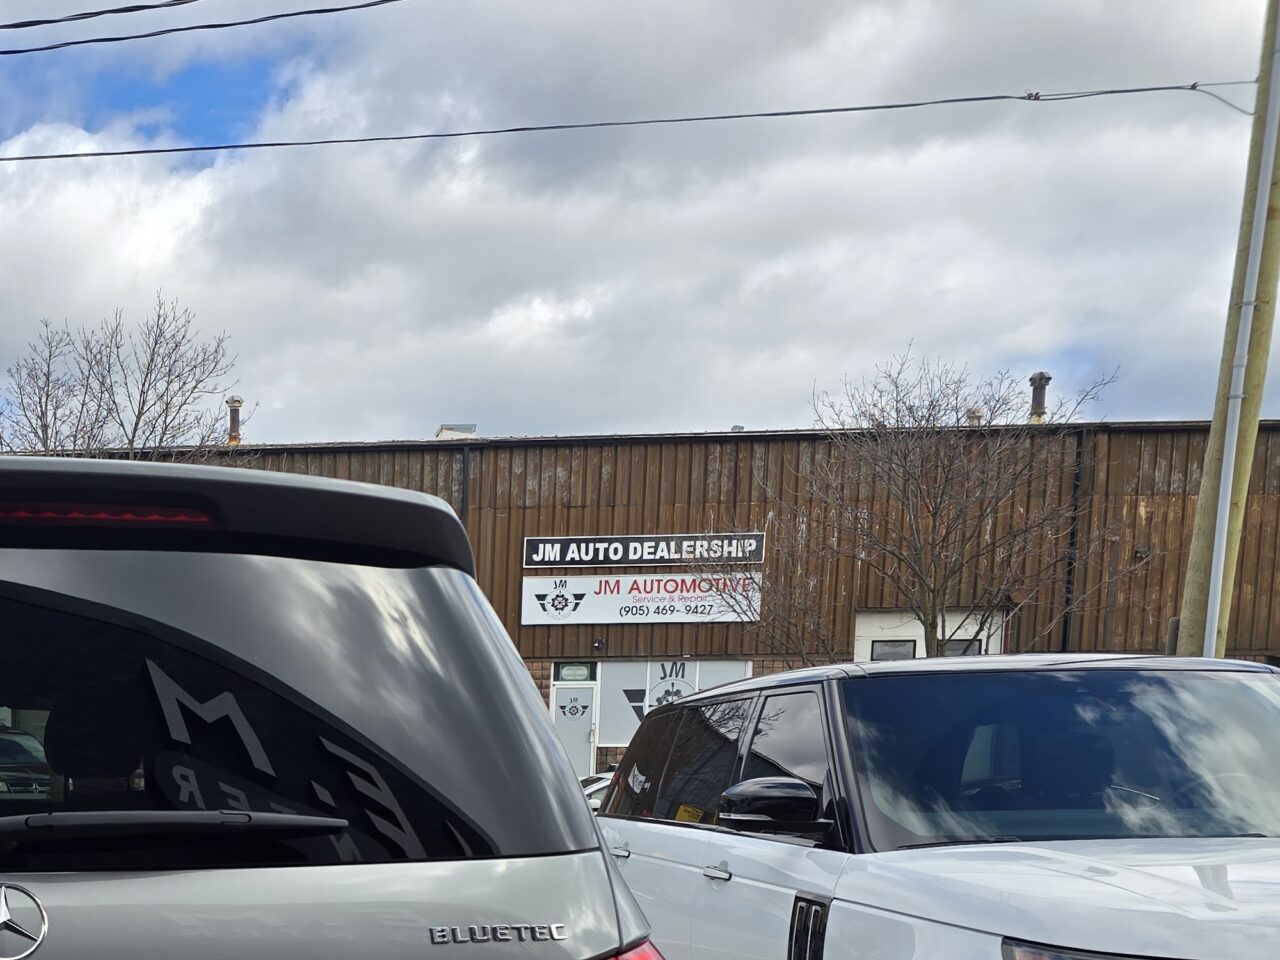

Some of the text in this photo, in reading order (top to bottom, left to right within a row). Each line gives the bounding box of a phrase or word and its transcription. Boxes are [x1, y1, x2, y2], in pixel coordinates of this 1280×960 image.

[532, 539, 757, 562] JM AUTO DEALERSHIP
[553, 579, 567, 590] JM
[593, 577, 754, 596] JM AUTOMOTIVE
[632, 594, 708, 605] Service & Repair
[619, 605, 650, 617] (905)
[684, 604, 714, 616] 9427
[659, 660, 686, 681] JM
[429, 923, 569, 945] BLUETEC
